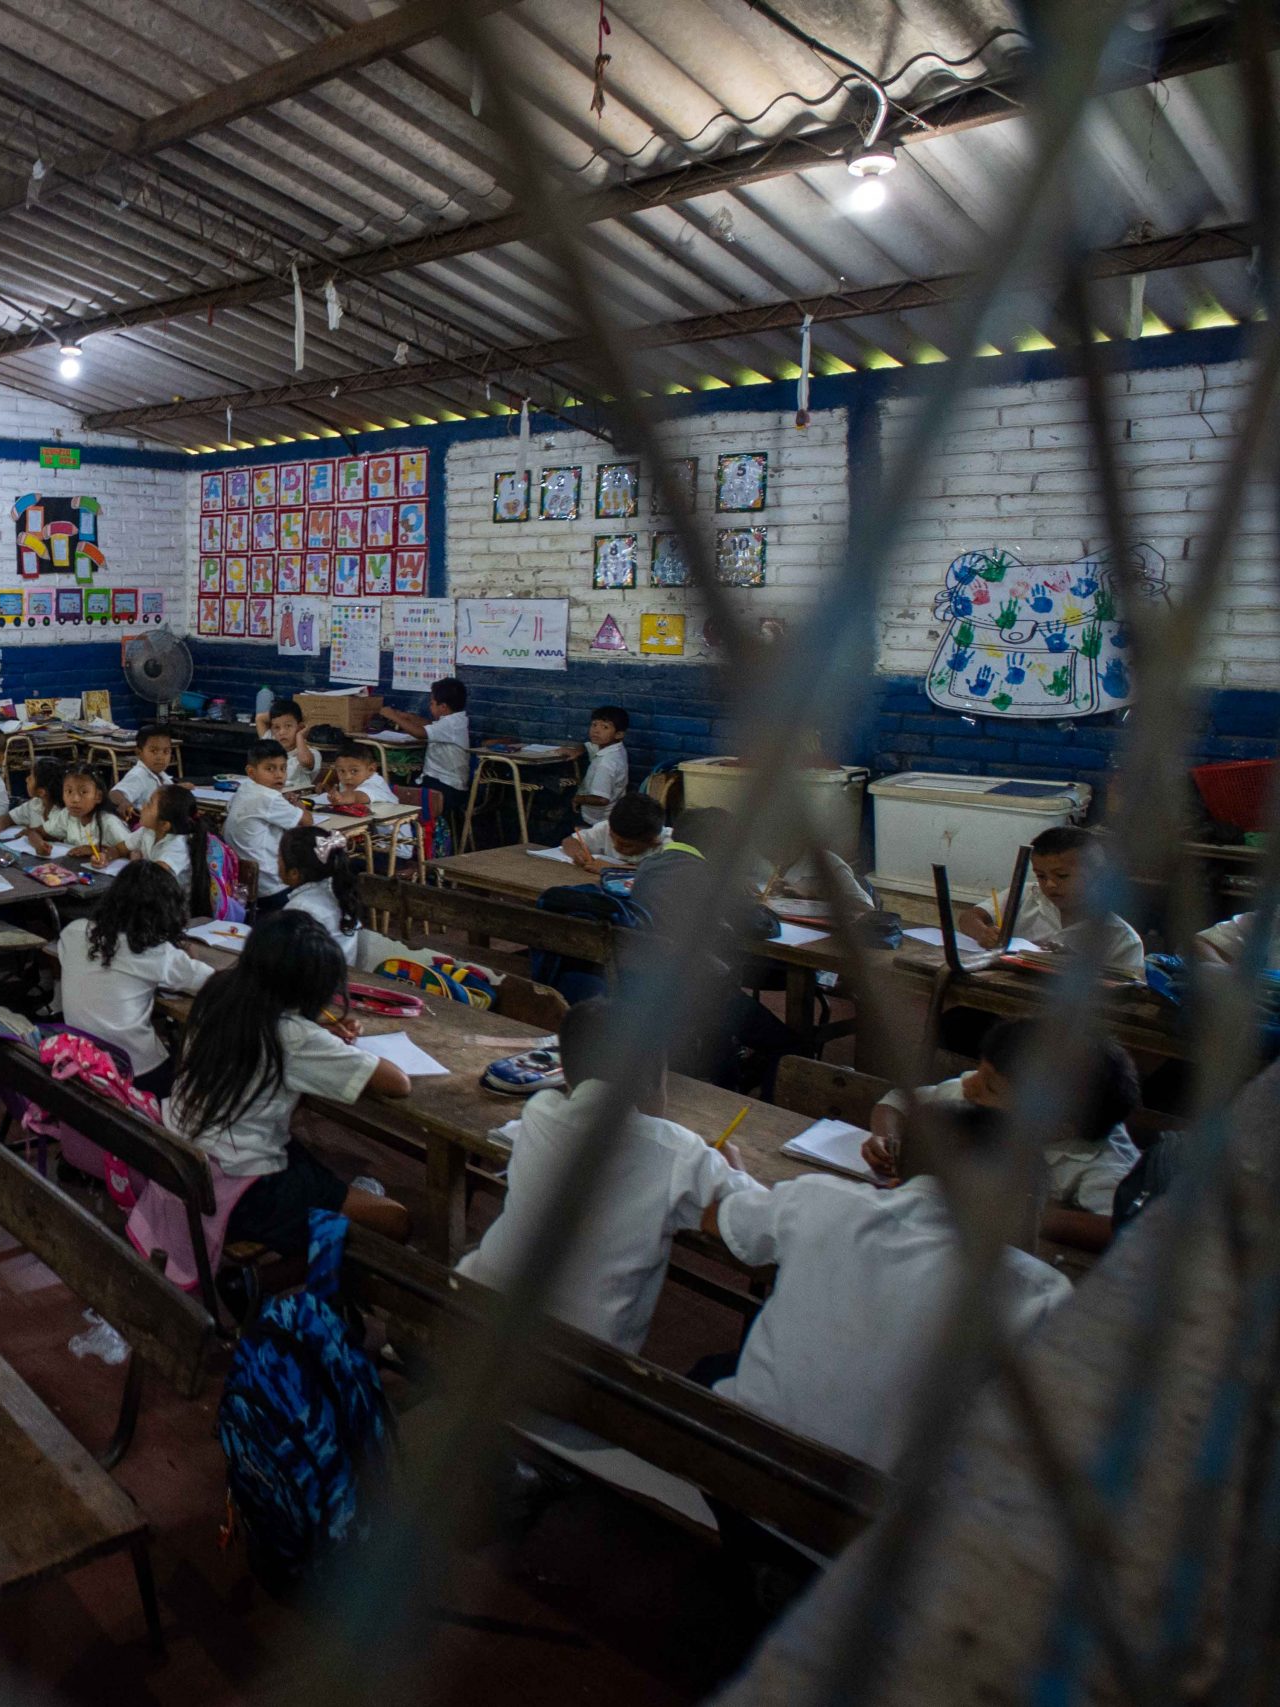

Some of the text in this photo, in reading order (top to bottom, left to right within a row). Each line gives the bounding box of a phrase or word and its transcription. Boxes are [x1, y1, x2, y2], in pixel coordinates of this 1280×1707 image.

[344, 463, 359, 486] F
[371, 460, 391, 484] G
[402, 455, 423, 481] H
[737, 463, 747, 476] 5
[509, 479, 515, 490] 1
[311, 512, 331, 535] M
[610, 543, 618, 556] 8
[730, 537, 750, 551] 10
[205, 559, 219, 580] P
[397, 554, 425, 578] W
